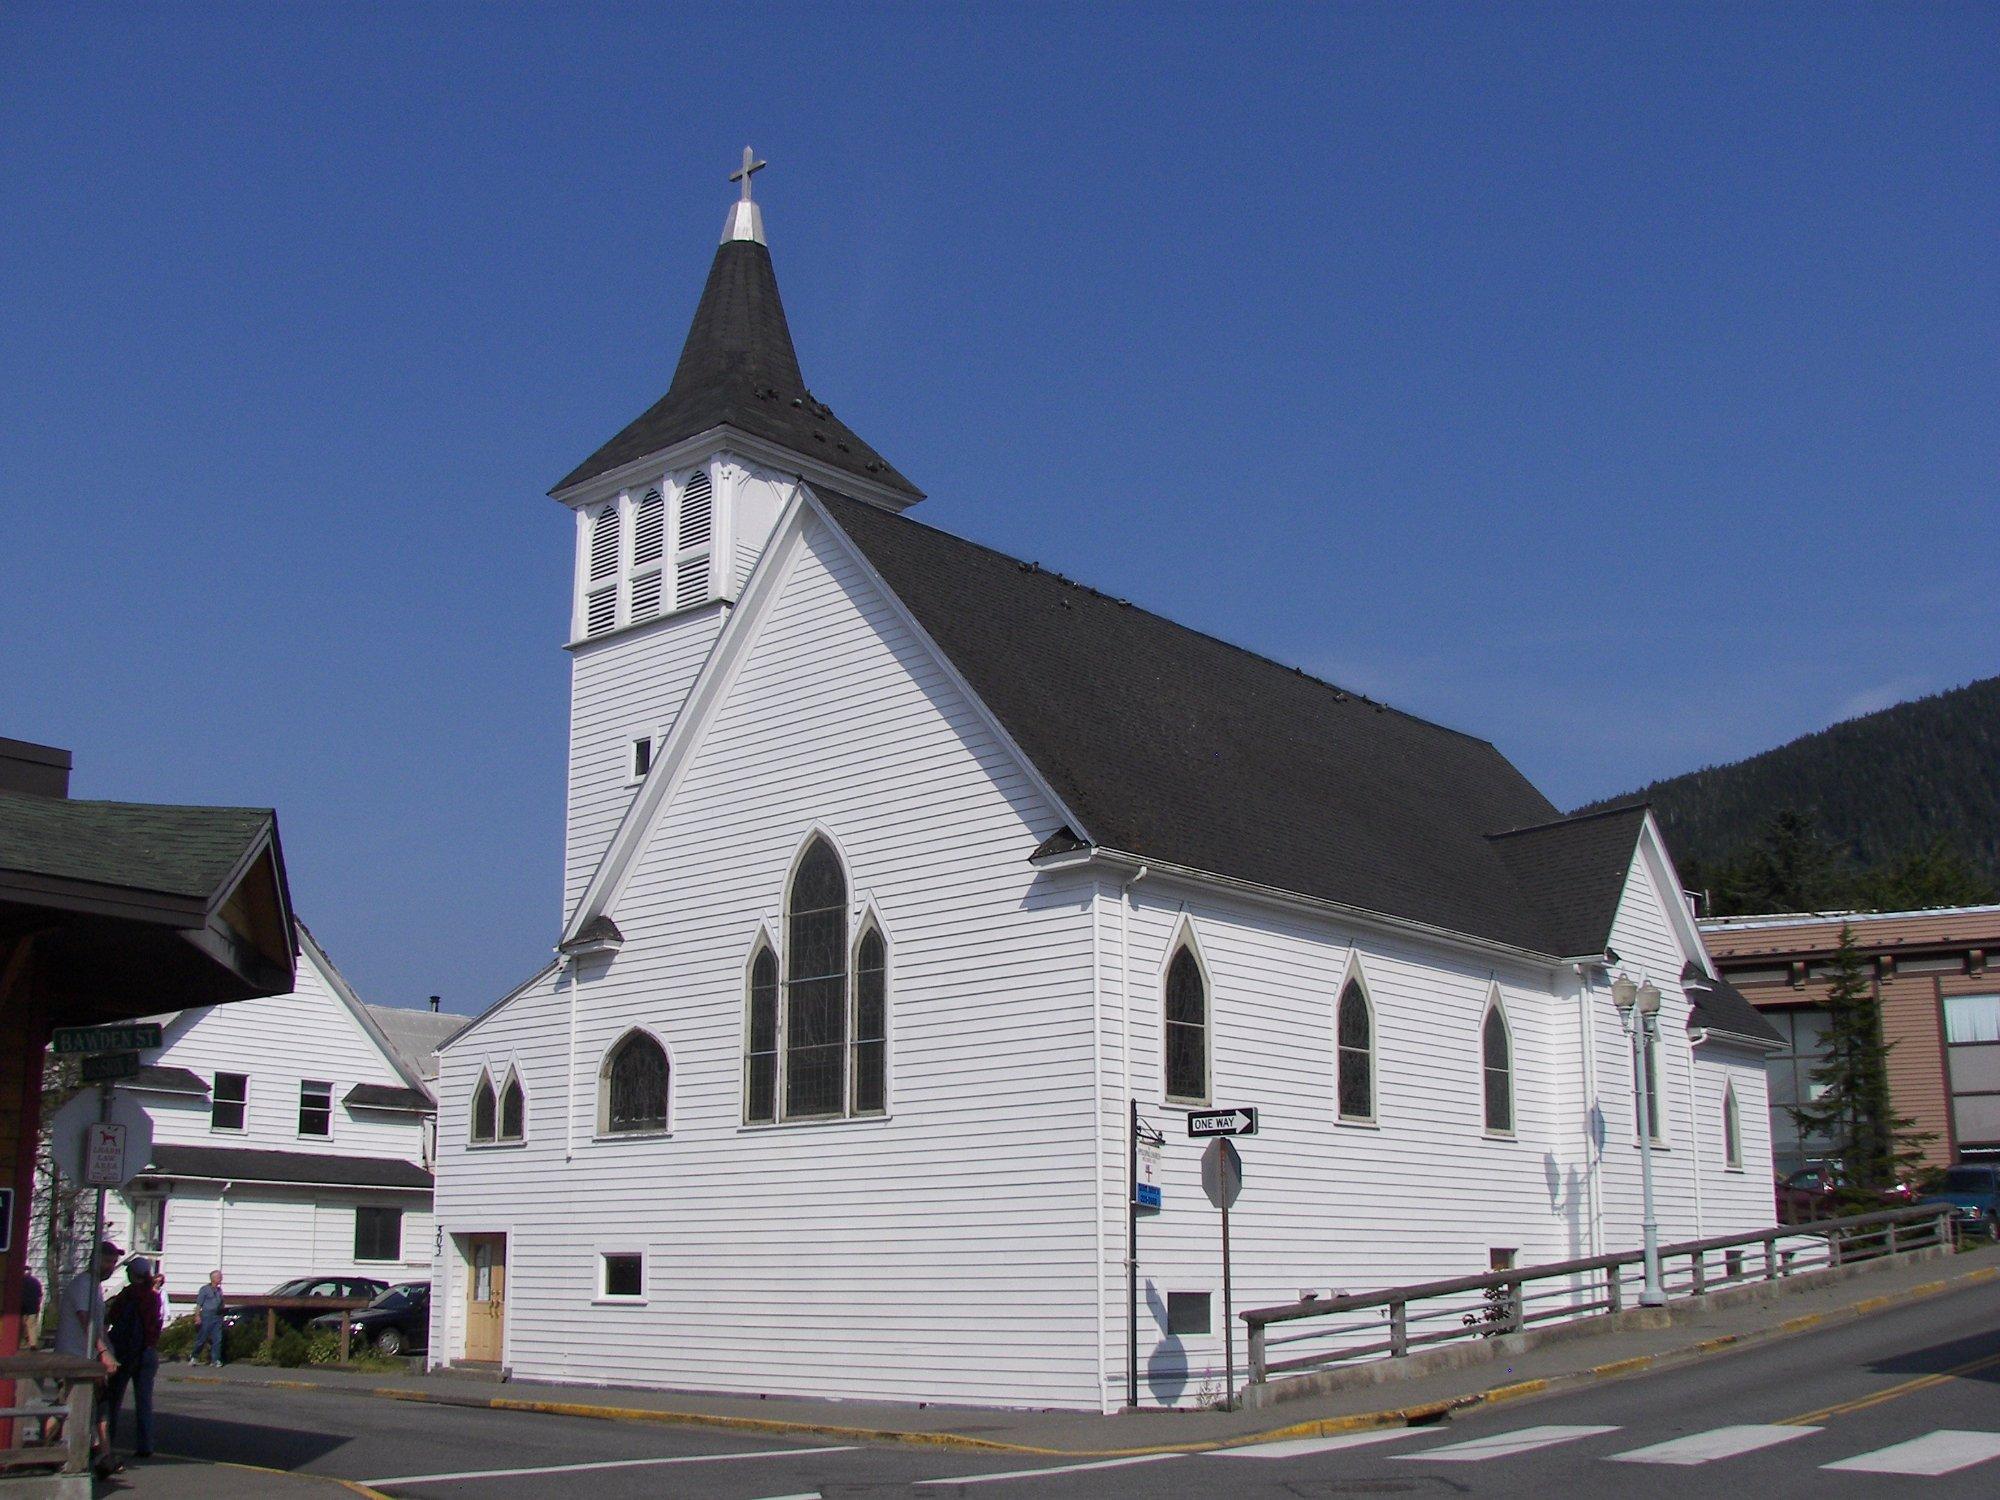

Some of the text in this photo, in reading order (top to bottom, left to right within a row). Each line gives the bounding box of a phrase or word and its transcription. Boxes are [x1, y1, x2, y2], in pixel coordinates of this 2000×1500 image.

[60, 1028, 155, 1052] BAWDEN ST
[1195, 1117, 1234, 1129] ONE WAY
